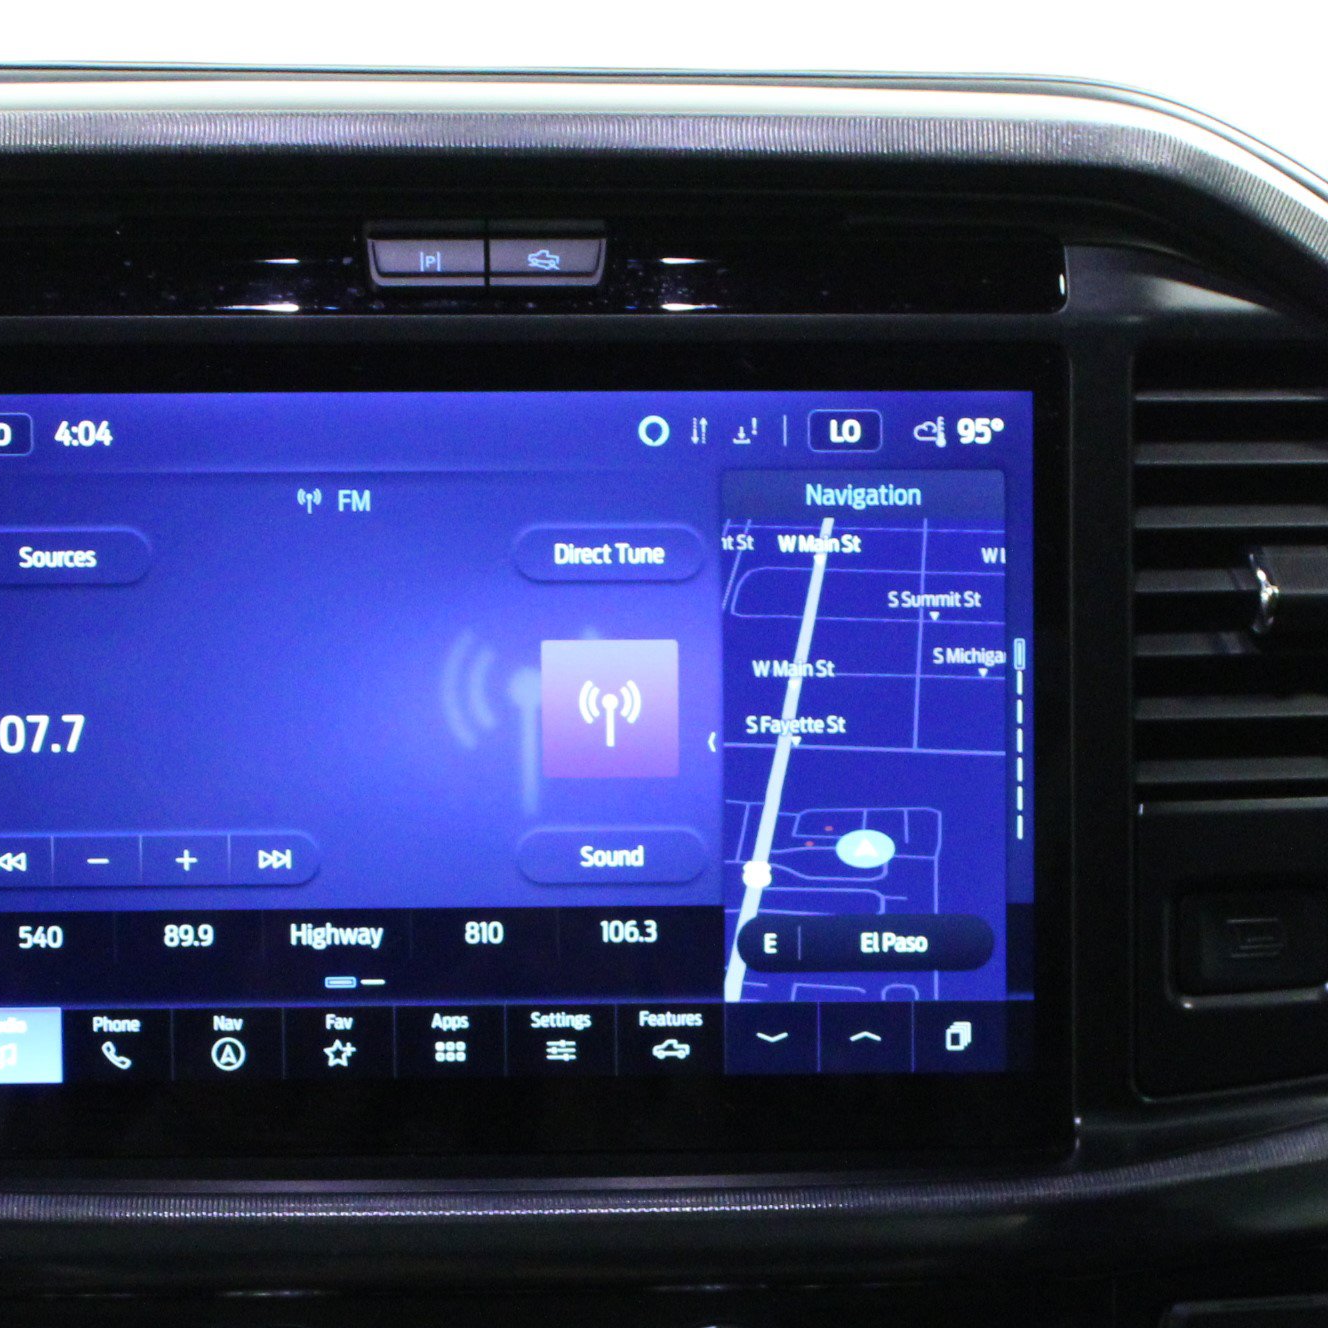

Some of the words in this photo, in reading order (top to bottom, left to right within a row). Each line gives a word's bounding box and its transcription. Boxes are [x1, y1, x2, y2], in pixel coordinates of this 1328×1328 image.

[54, 420, 113, 447] 4:04
[830, 418, 862, 444] LO
[338, 489, 371, 513] FM
[805, 483, 922, 511] Navigation
[736, 534, 755, 550] St
[777, 534, 798, 552] W
[798, 534, 841, 552] Main
[841, 534, 862, 552] St
[18, 546, 97, 569] Sources
[554, 543, 611, 566] Direct
[616, 542, 666, 565] Tune
[981, 547, 998, 563] W
[888, 591, 900, 608] S
[901, 591, 961, 608] Summit
[963, 591, 982, 608] St
[932, 647, 944, 664] S
[752, 660, 770, 677] W
[772, 660, 813, 678] Main
[815, 660, 835, 678] St
[745, 716, 759, 734] S
[760, 716, 826, 736] Fayette
[826, 715, 846, 734] St
[580, 846, 644, 867] Sound
[19, 926, 63, 949] 540
[164, 924, 214, 948] 89.9
[290, 923, 384, 949] Highway
[465, 921, 504, 944] 810
[600, 920, 658, 944] 106.3
[860, 931, 879, 953] El
[882, 932, 928, 953] Paso
[764, 933, 777, 953] E
[92, 1016, 141, 1034] Phone
[213, 1015, 243, 1032] Nav
[325, 1013, 354, 1031] Fav
[431, 1013, 469, 1034] Apps
[530, 1011, 591, 1032] Settings
[639, 1010, 703, 1028] Features
